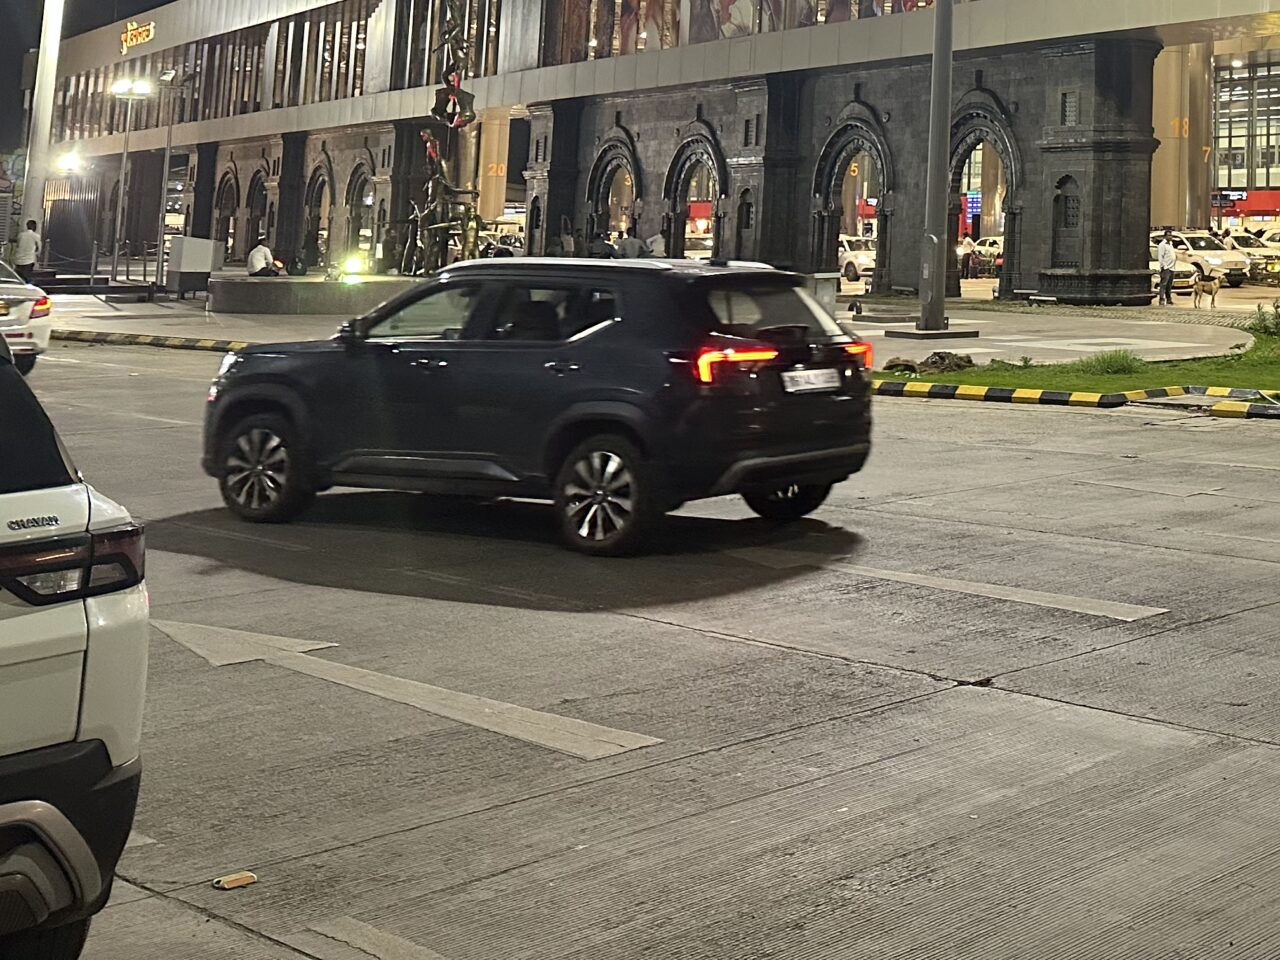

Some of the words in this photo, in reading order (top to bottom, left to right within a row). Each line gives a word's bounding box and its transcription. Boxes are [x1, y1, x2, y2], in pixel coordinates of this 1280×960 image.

[1170, 117, 1189, 139] 18
[1202, 145, 1211, 163] 7
[487, 162, 506, 177] 20
[850, 162, 859, 176] 5
[624, 174, 632, 186] 3
